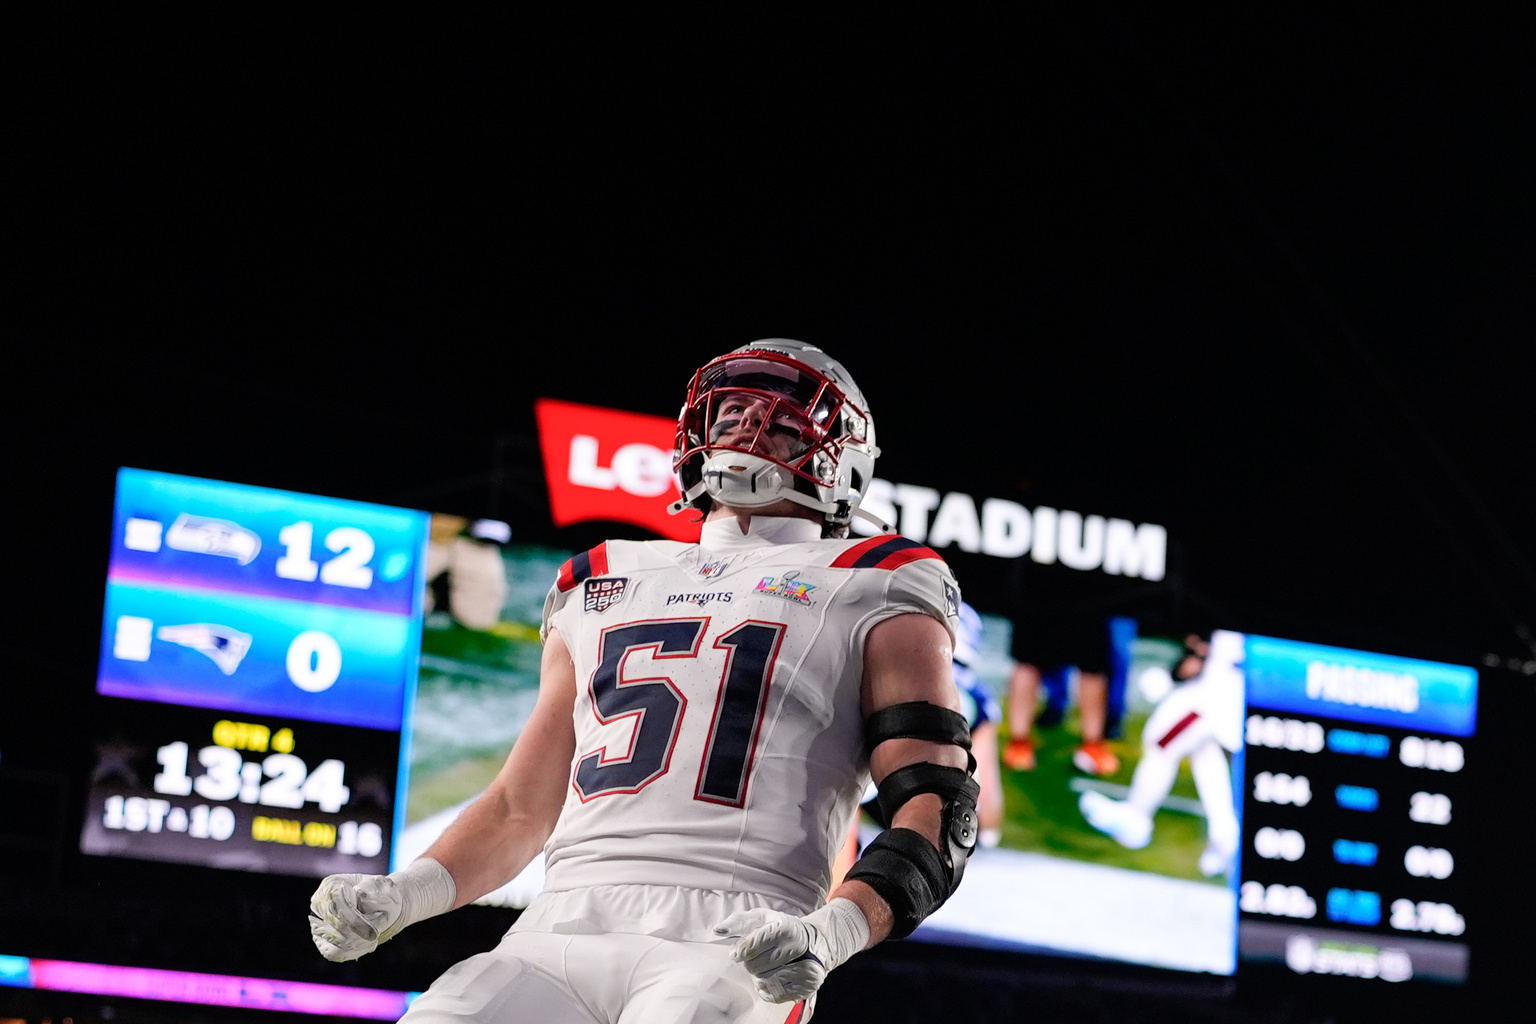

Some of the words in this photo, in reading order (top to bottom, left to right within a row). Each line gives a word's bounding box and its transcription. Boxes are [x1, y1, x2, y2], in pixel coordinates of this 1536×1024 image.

[568, 434, 680, 497] Le
[275, 521, 375, 590] 12
[585, 593, 623, 611] 250
[588, 581, 624, 593] USA
[666, 591, 734, 606] PATRIOTS
[286, 630, 342, 692] 0
[573, 616, 787, 808] 51
[154, 741, 350, 813] 13:24
[103, 794, 171, 833] 1ST
[188, 804, 235, 841] 10
